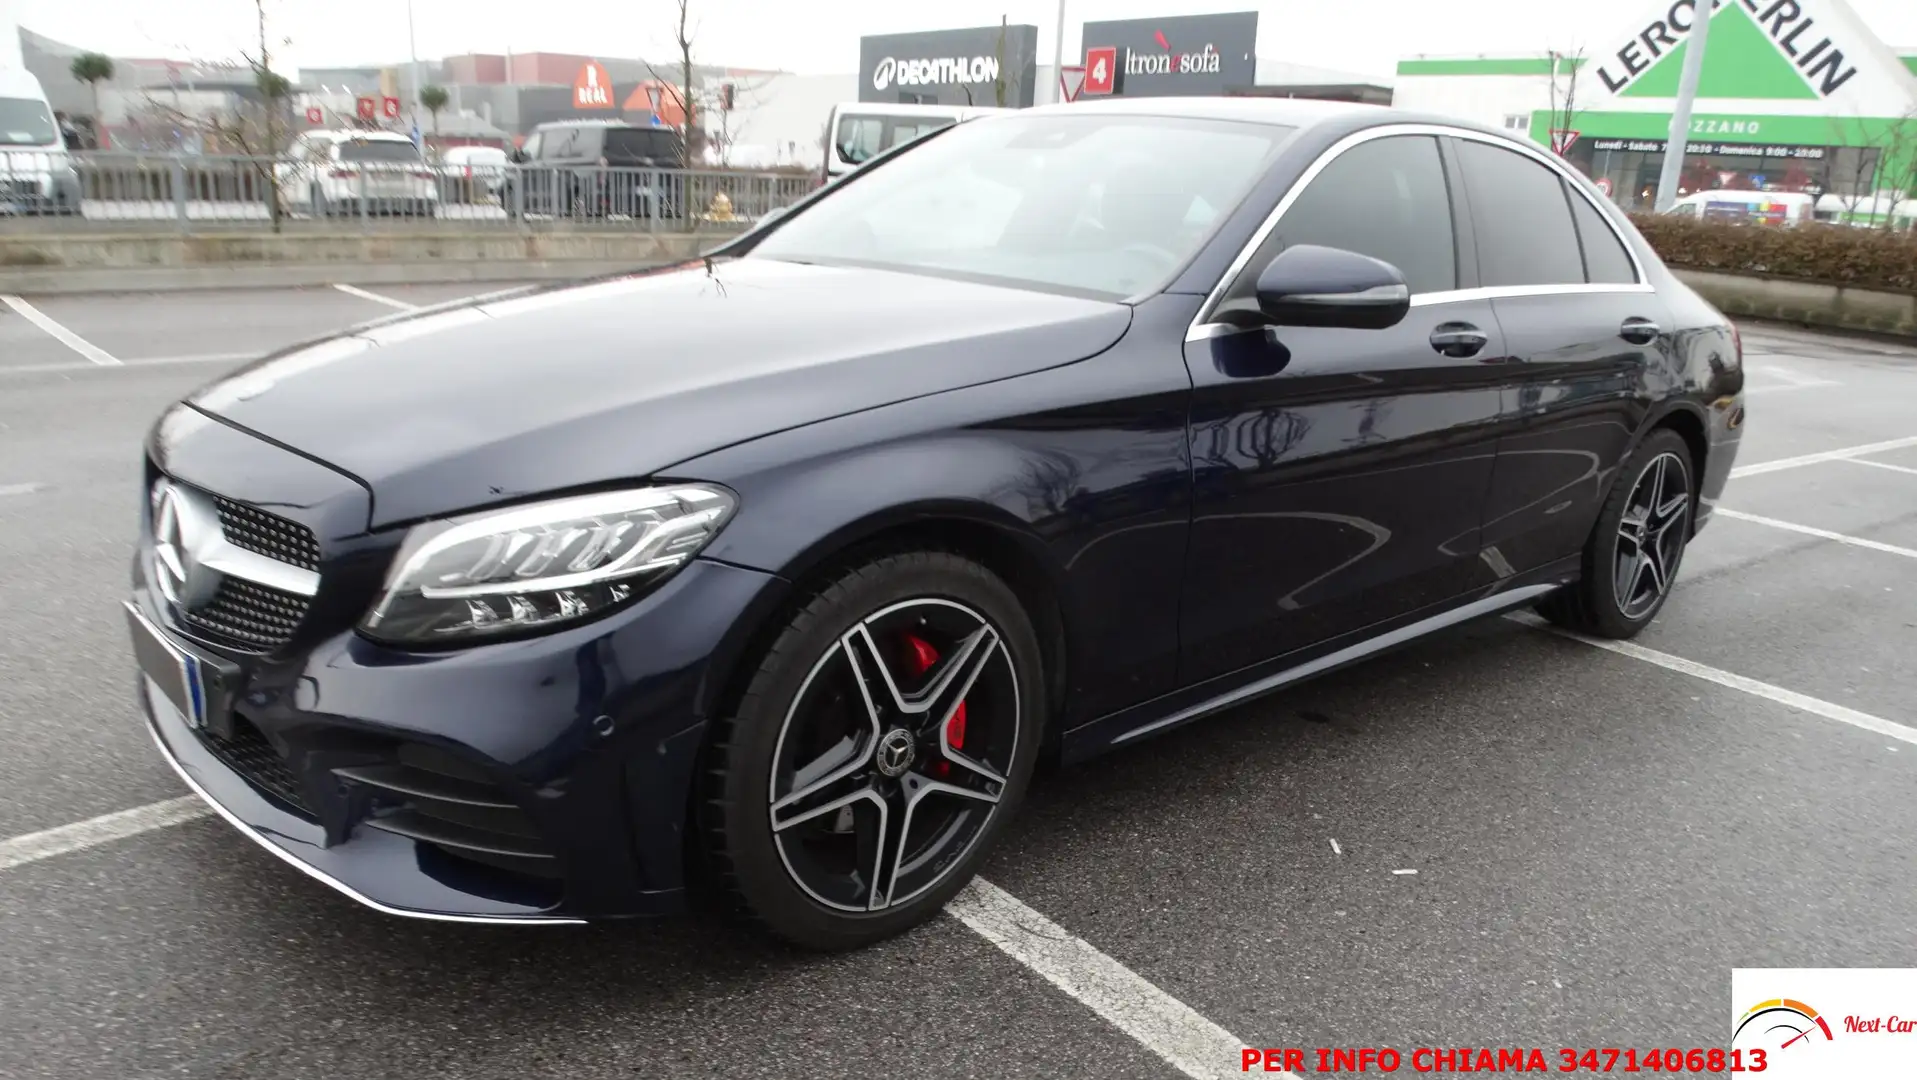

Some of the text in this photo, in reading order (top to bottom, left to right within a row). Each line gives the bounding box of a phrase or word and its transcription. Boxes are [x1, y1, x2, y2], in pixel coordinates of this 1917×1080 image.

[1597, 0, 1719, 93] LERO
[897, 56, 999, 85] DECATHLON
[1092, 57, 1107, 84] 4
[1668, 119, 1760, 134] ZZANO
